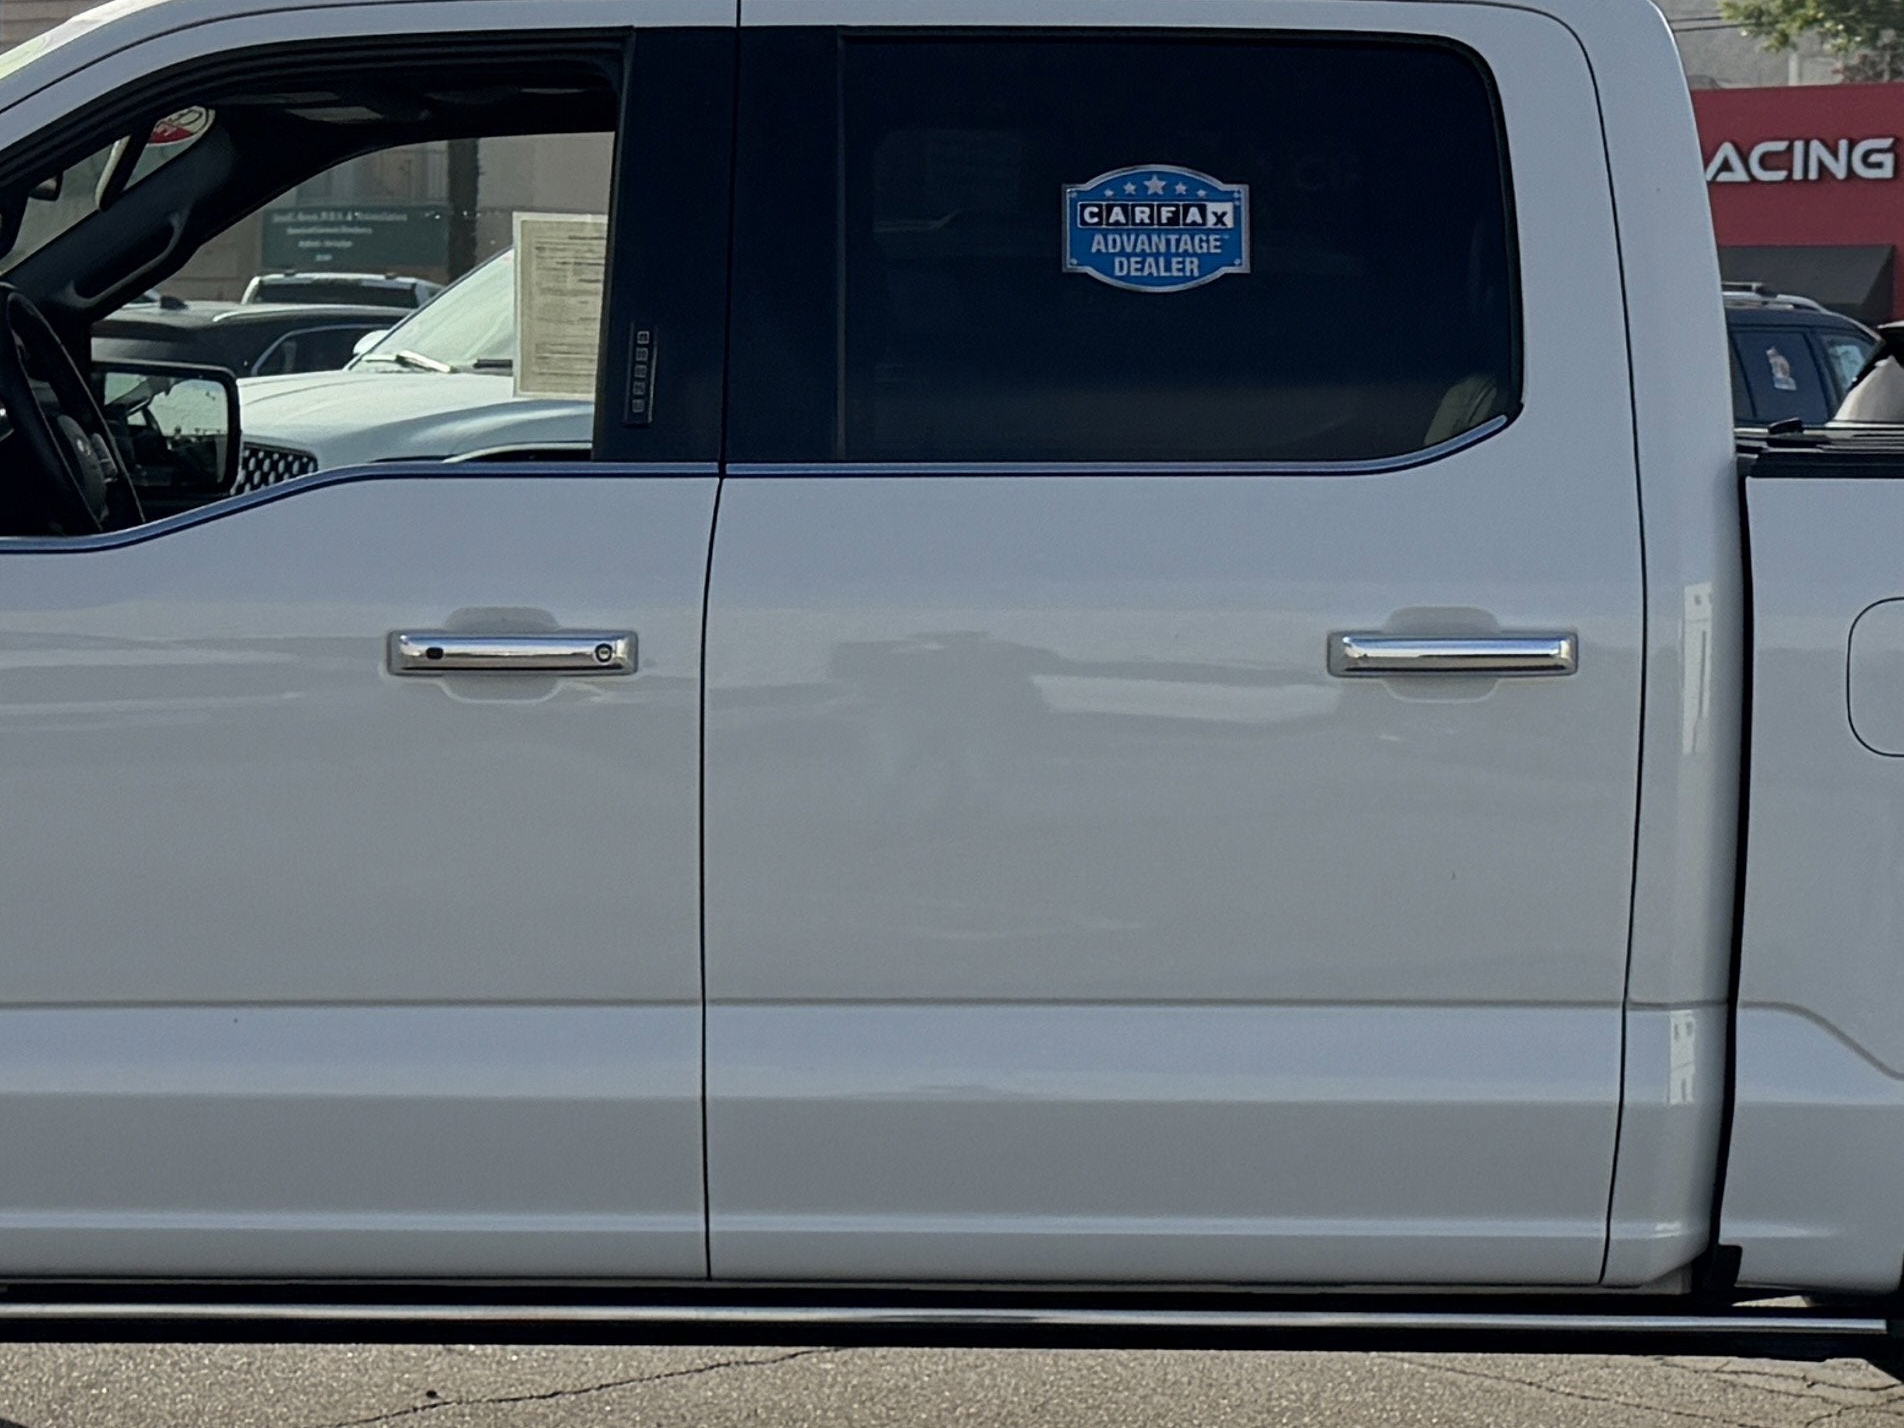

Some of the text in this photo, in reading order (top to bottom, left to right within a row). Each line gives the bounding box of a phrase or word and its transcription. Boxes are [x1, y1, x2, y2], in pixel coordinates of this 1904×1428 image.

[1705, 137, 1895, 182] ACING
[1081, 204, 1230, 228] CARFAX
[1091, 233, 1222, 254] ADVANTAGE
[1114, 256, 1200, 277] DEALER
